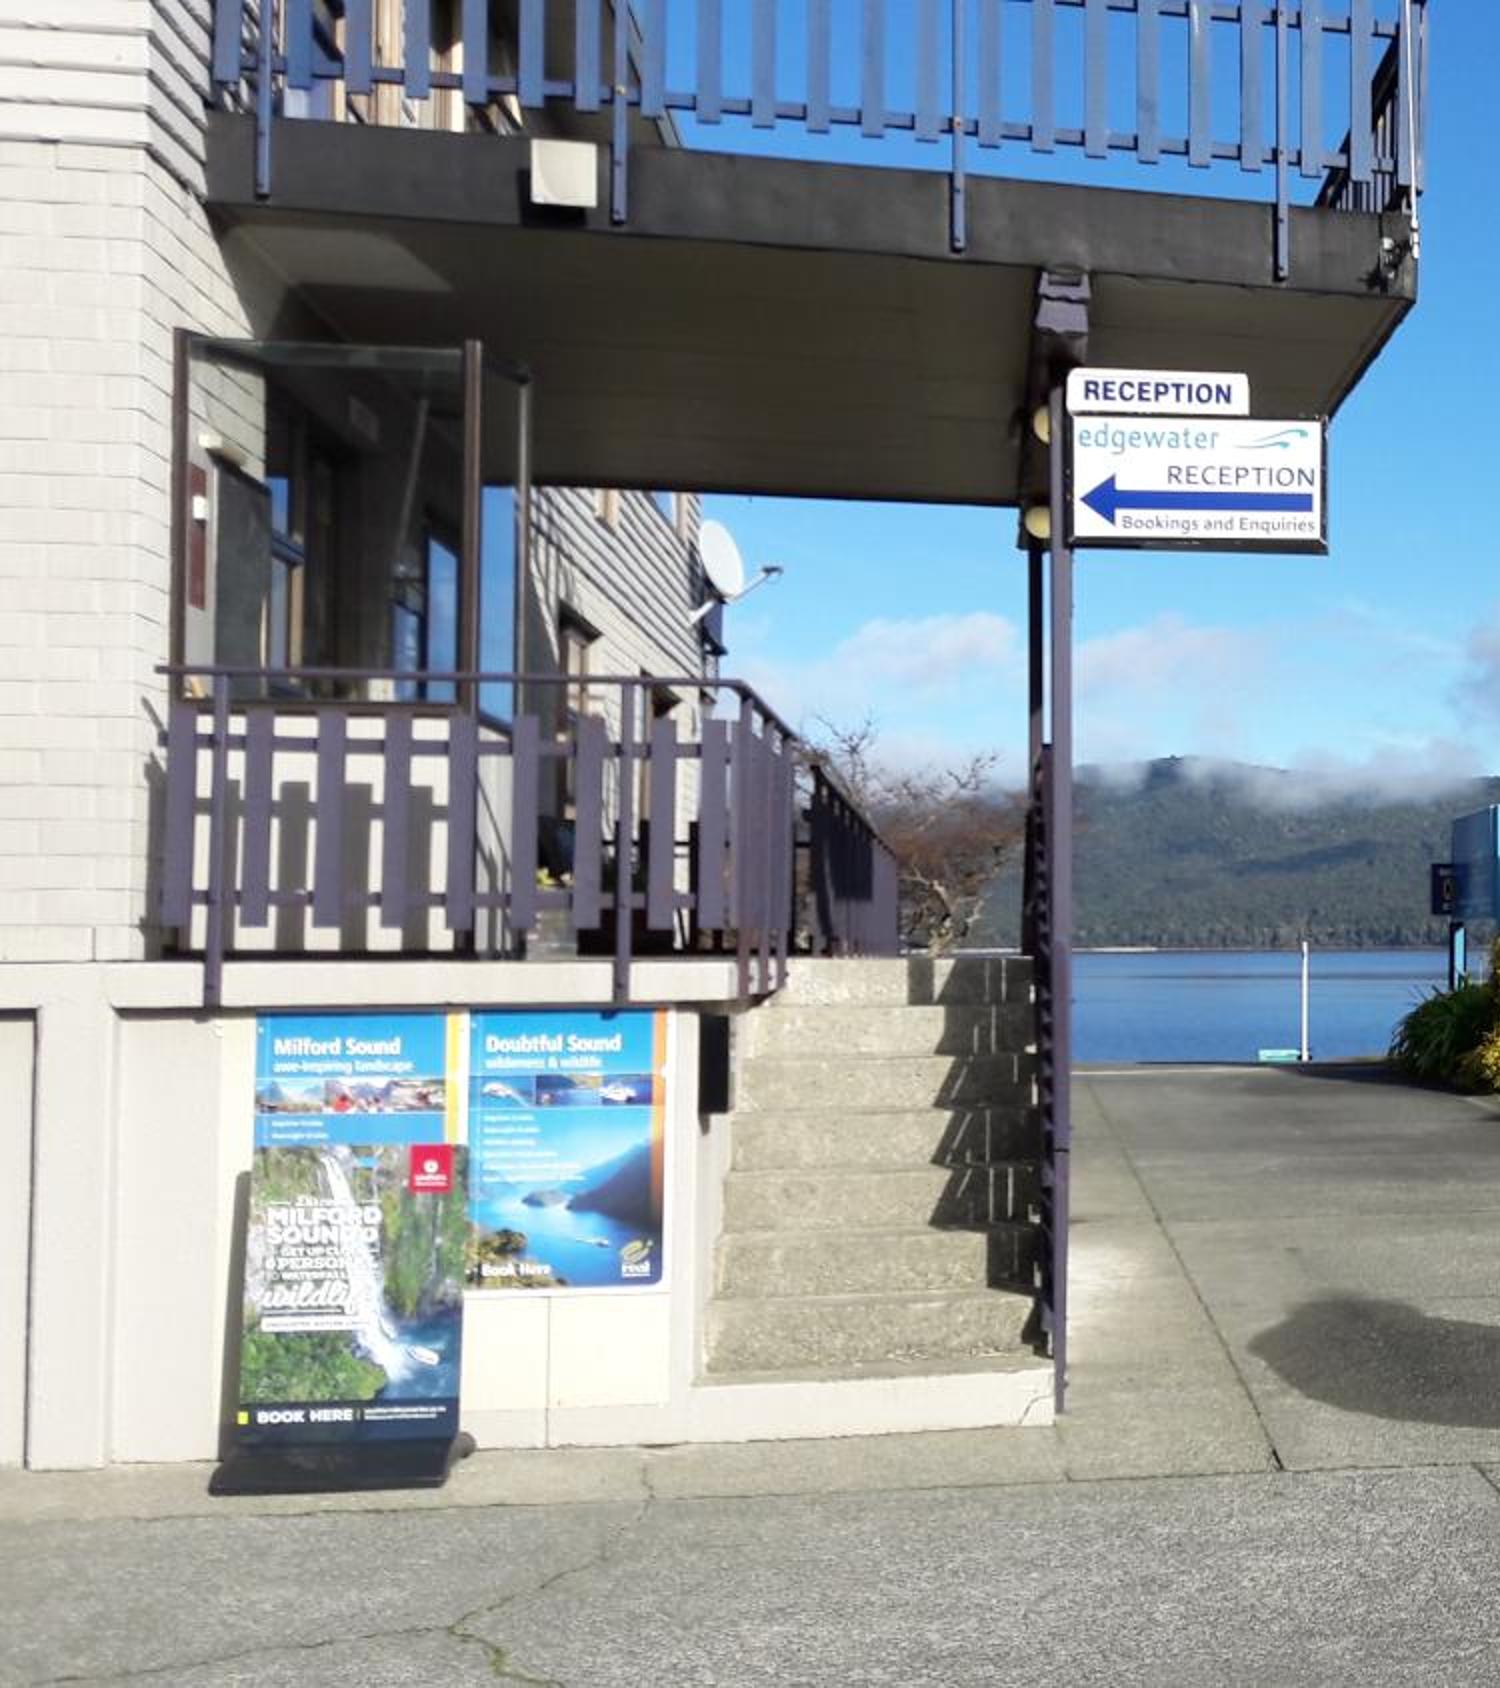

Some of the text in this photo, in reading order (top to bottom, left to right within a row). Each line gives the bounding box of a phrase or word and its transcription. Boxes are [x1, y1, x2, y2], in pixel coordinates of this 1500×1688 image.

[1083, 379, 1233, 405] RECEPTION
[1078, 423, 1220, 455] edgewater
[1167, 465, 1316, 488] RECEPTION
[1121, 515, 1316, 535] Bookings and Enquiries
[274, 1037, 401, 1056] Milford Sound
[485, 1032, 623, 1053] Doubtful Sound
[266, 1206, 383, 1226] MILFORD
[481, 1263, 552, 1277] Book Here
[256, 1410, 305, 1425] BOOK
[309, 1408, 353, 1422] HERE
